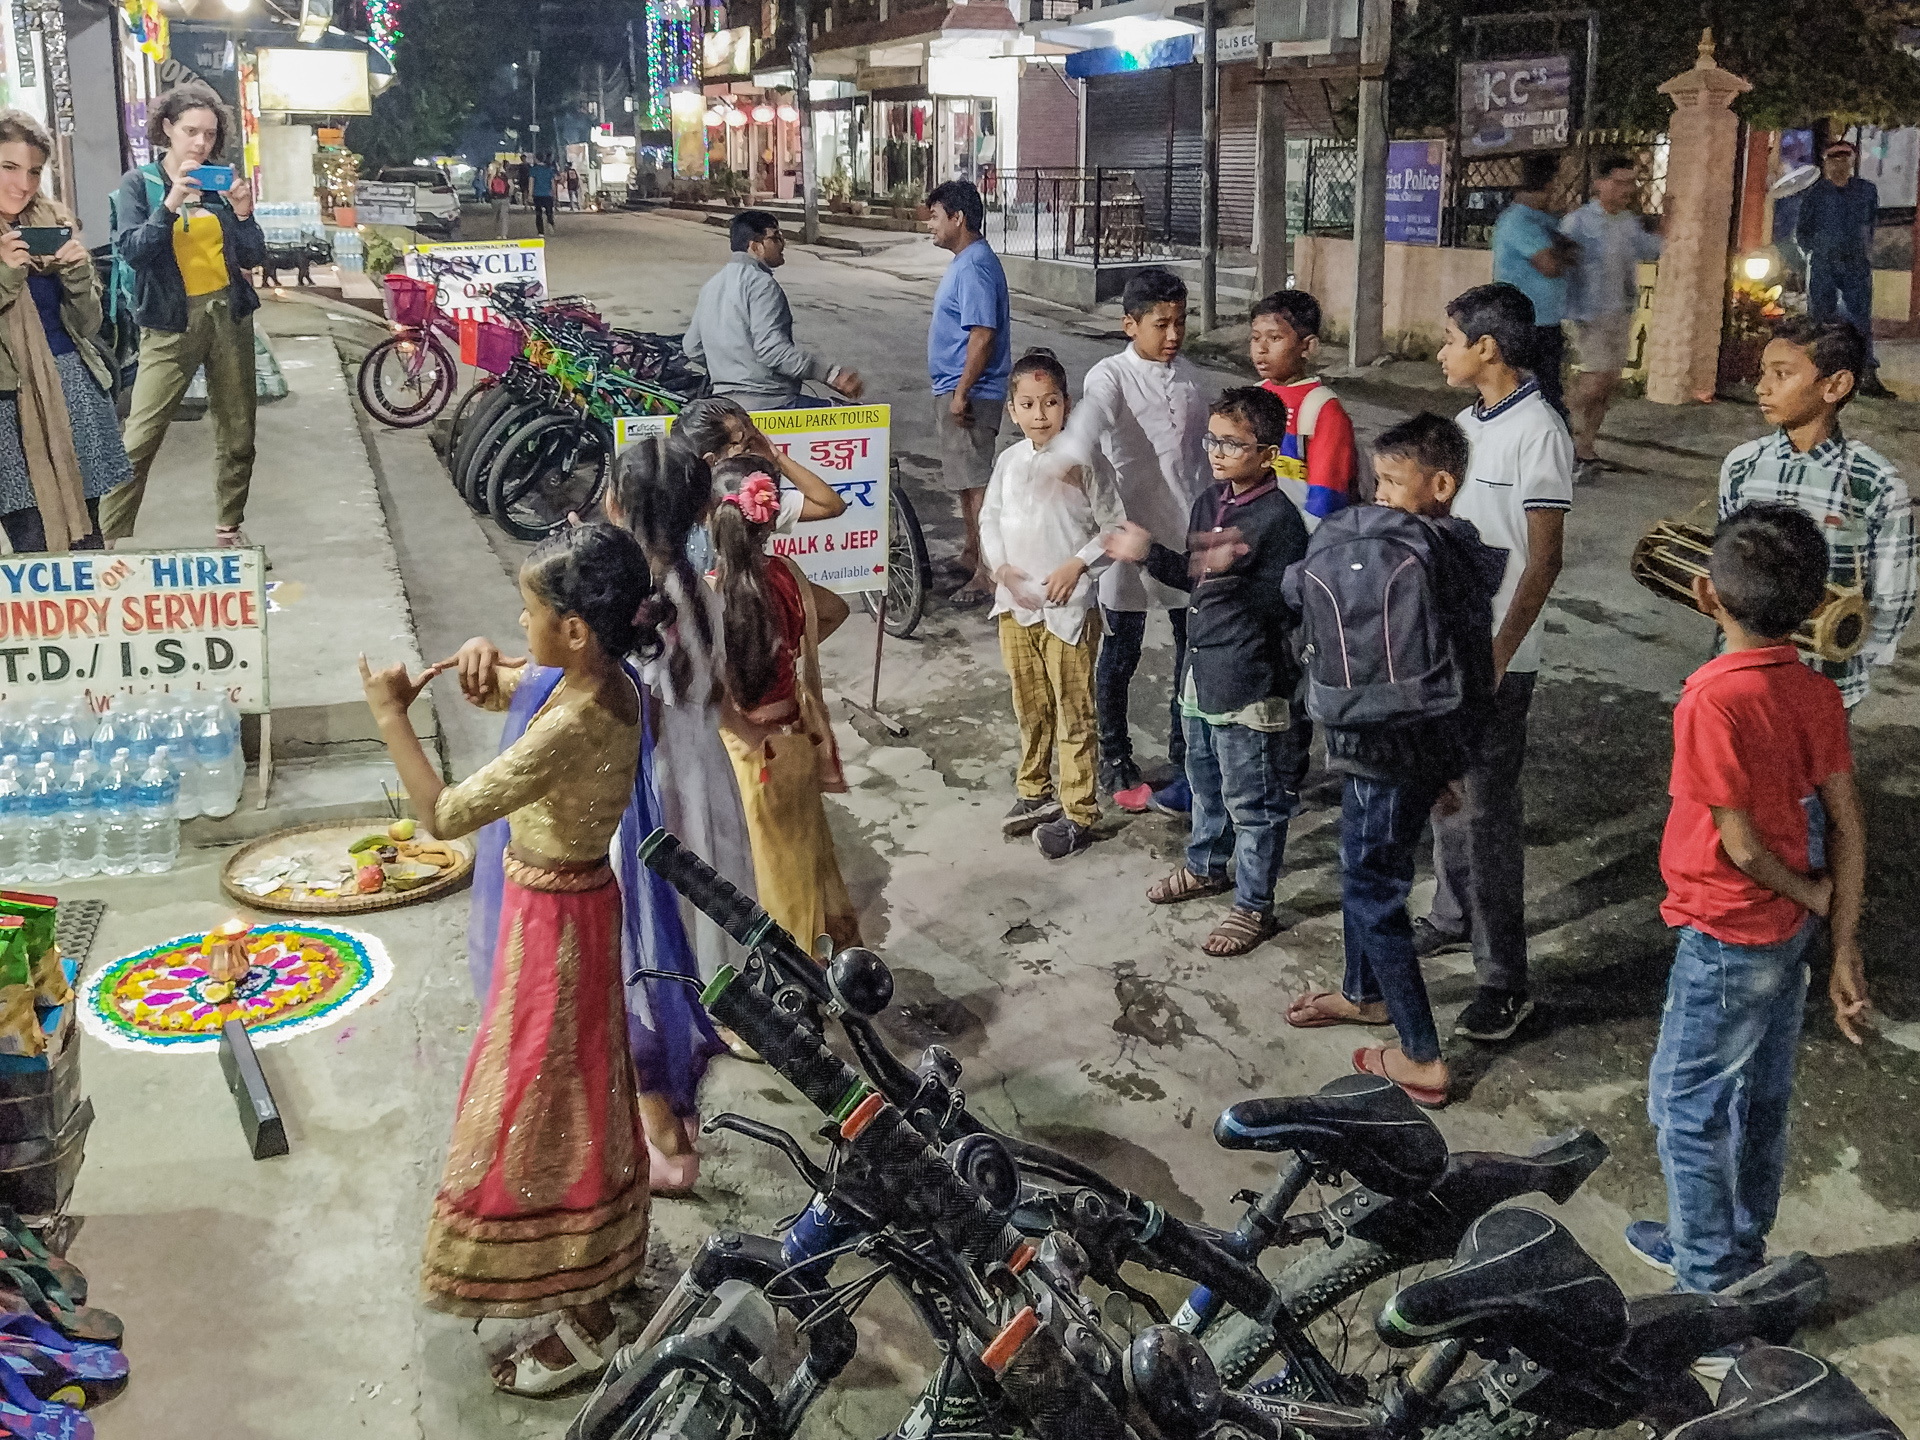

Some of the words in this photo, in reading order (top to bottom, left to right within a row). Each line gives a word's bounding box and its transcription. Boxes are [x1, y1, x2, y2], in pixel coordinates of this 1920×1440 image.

[1404, 168, 1440, 190] Police
[753, 415, 802, 430] TIONAL
[805, 413, 838, 427] PARK
[840, 410, 880, 424] TOURS
[773, 535, 818, 556] WALK
[824, 533, 835, 552] &
[840, 530, 879, 550] JEEP
[152, 555, 243, 588] HIRE
[820, 565, 870, 581] Available
[121, 591, 259, 633] SERVICE
[120, 637, 249, 677] I.S.D.
